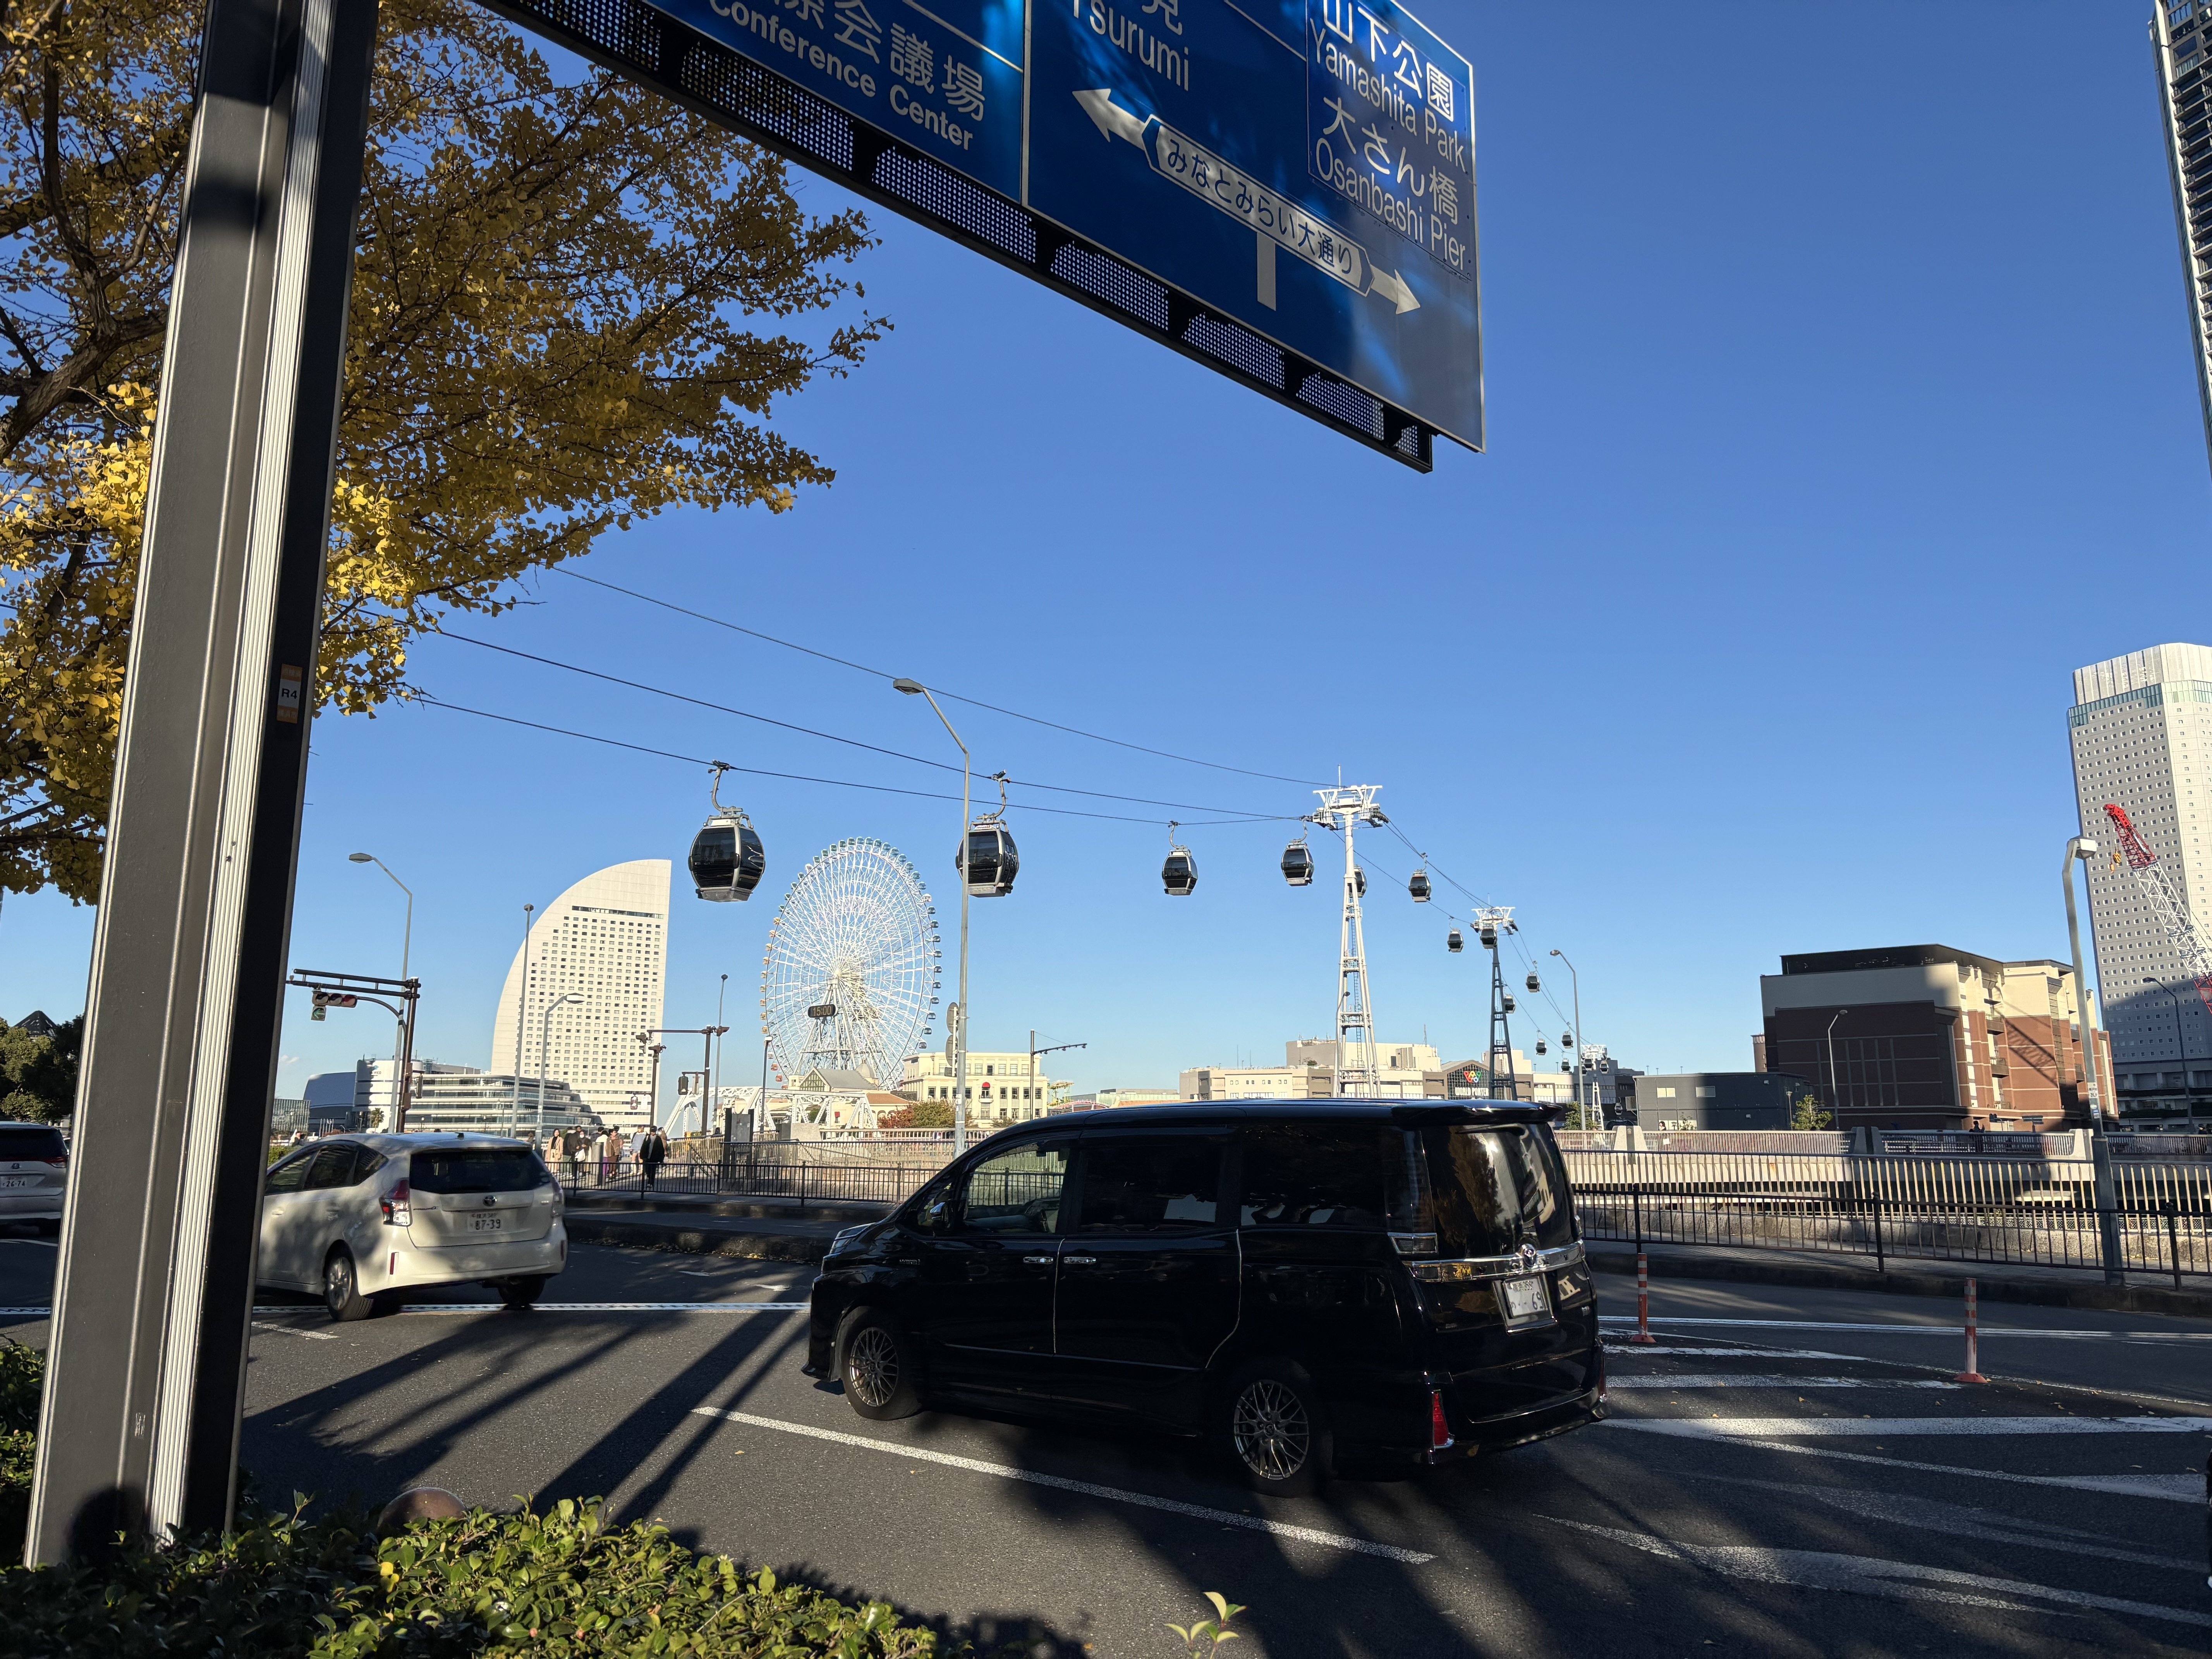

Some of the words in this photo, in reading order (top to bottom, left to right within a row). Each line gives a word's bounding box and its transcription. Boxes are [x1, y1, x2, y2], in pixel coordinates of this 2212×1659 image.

[709, 0, 876, 97] Conference
[890, 84, 973, 150] Center
[1310, 18, 1417, 136] Yamashita
[1425, 107, 1466, 172] Park
[1324, 0, 1453, 122] 山下公園
[1168, 139, 1352, 273] みなとみらい大通り
[1316, 138, 1423, 243] Osanbashi
[1431, 214, 1465, 270] Pier
[1323, 97, 1458, 225] 大さん橋
[282, 689, 297, 699] R4
[813, 1005, 831, 1016] 15:00
[1455, 1087, 1471, 1096] WORLD
